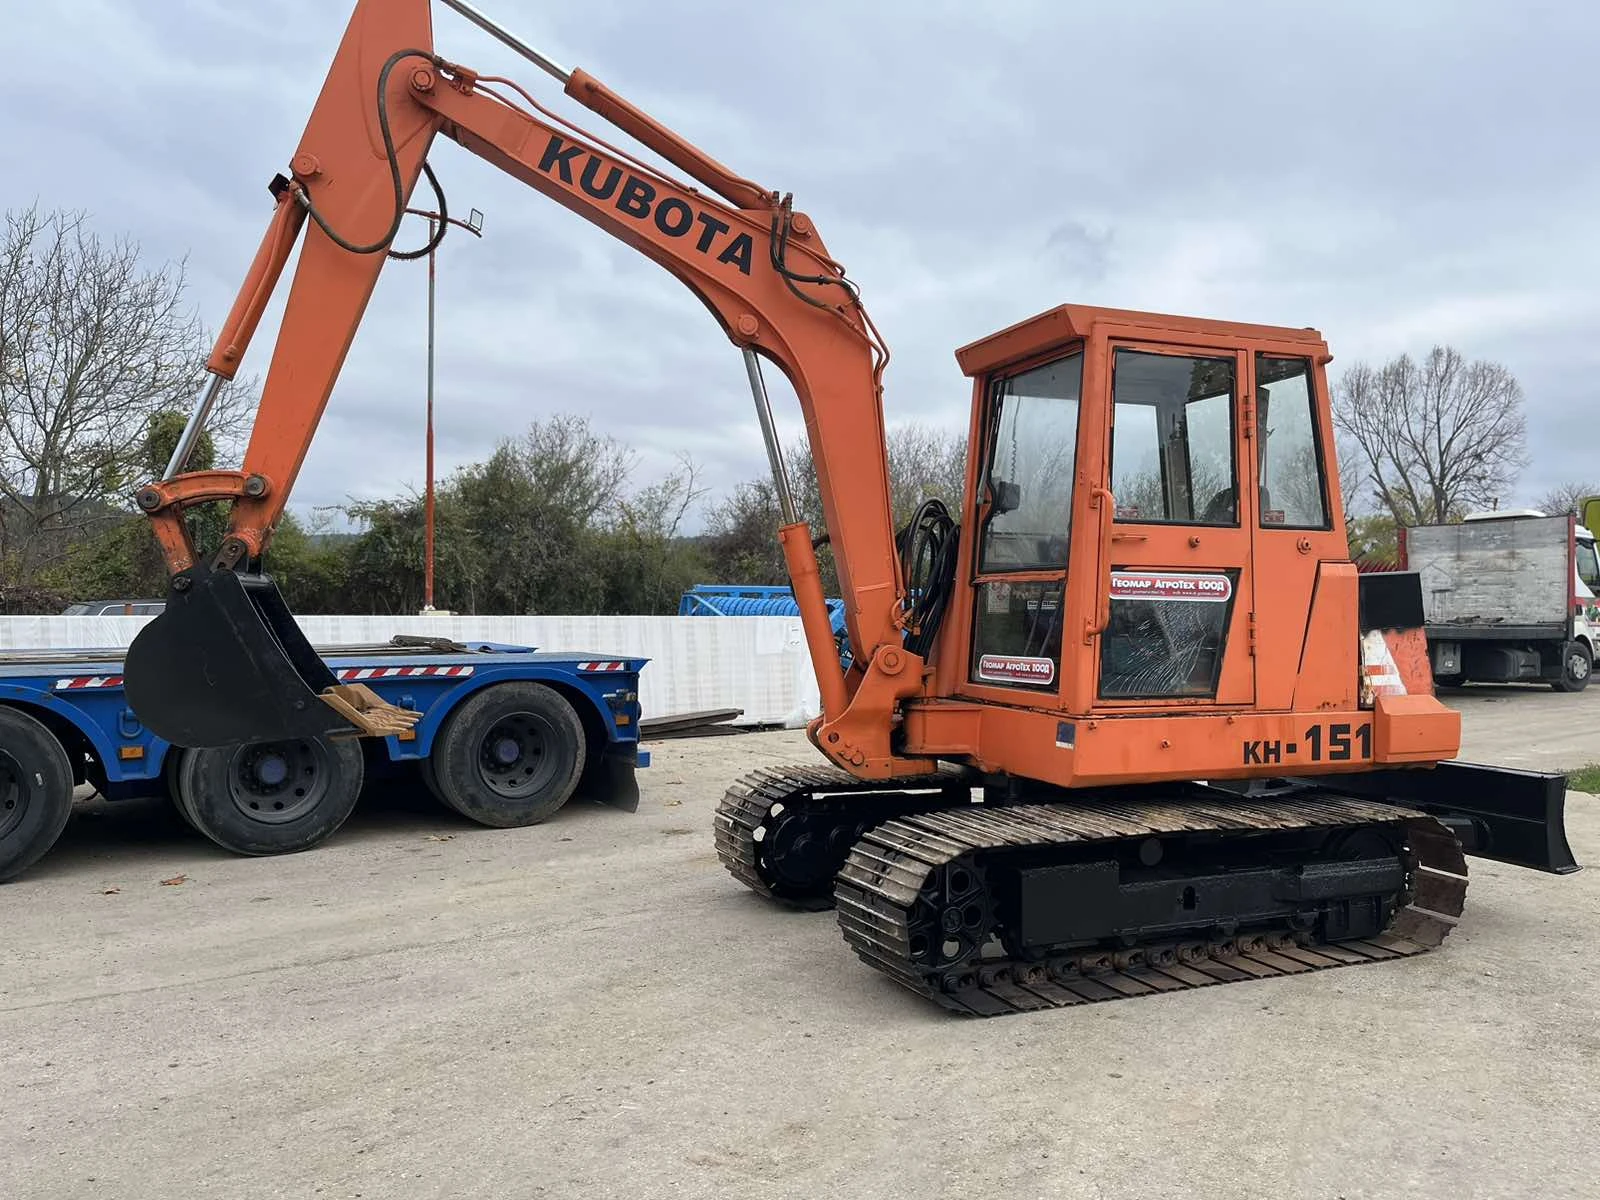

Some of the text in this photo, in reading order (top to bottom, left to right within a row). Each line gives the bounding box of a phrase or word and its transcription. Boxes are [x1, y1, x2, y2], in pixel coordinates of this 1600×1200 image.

[537, 134, 753, 276] KUBOTA
[1198, 580, 1225, 591] ЕООД
[1243, 723, 1371, 764] KH-151
